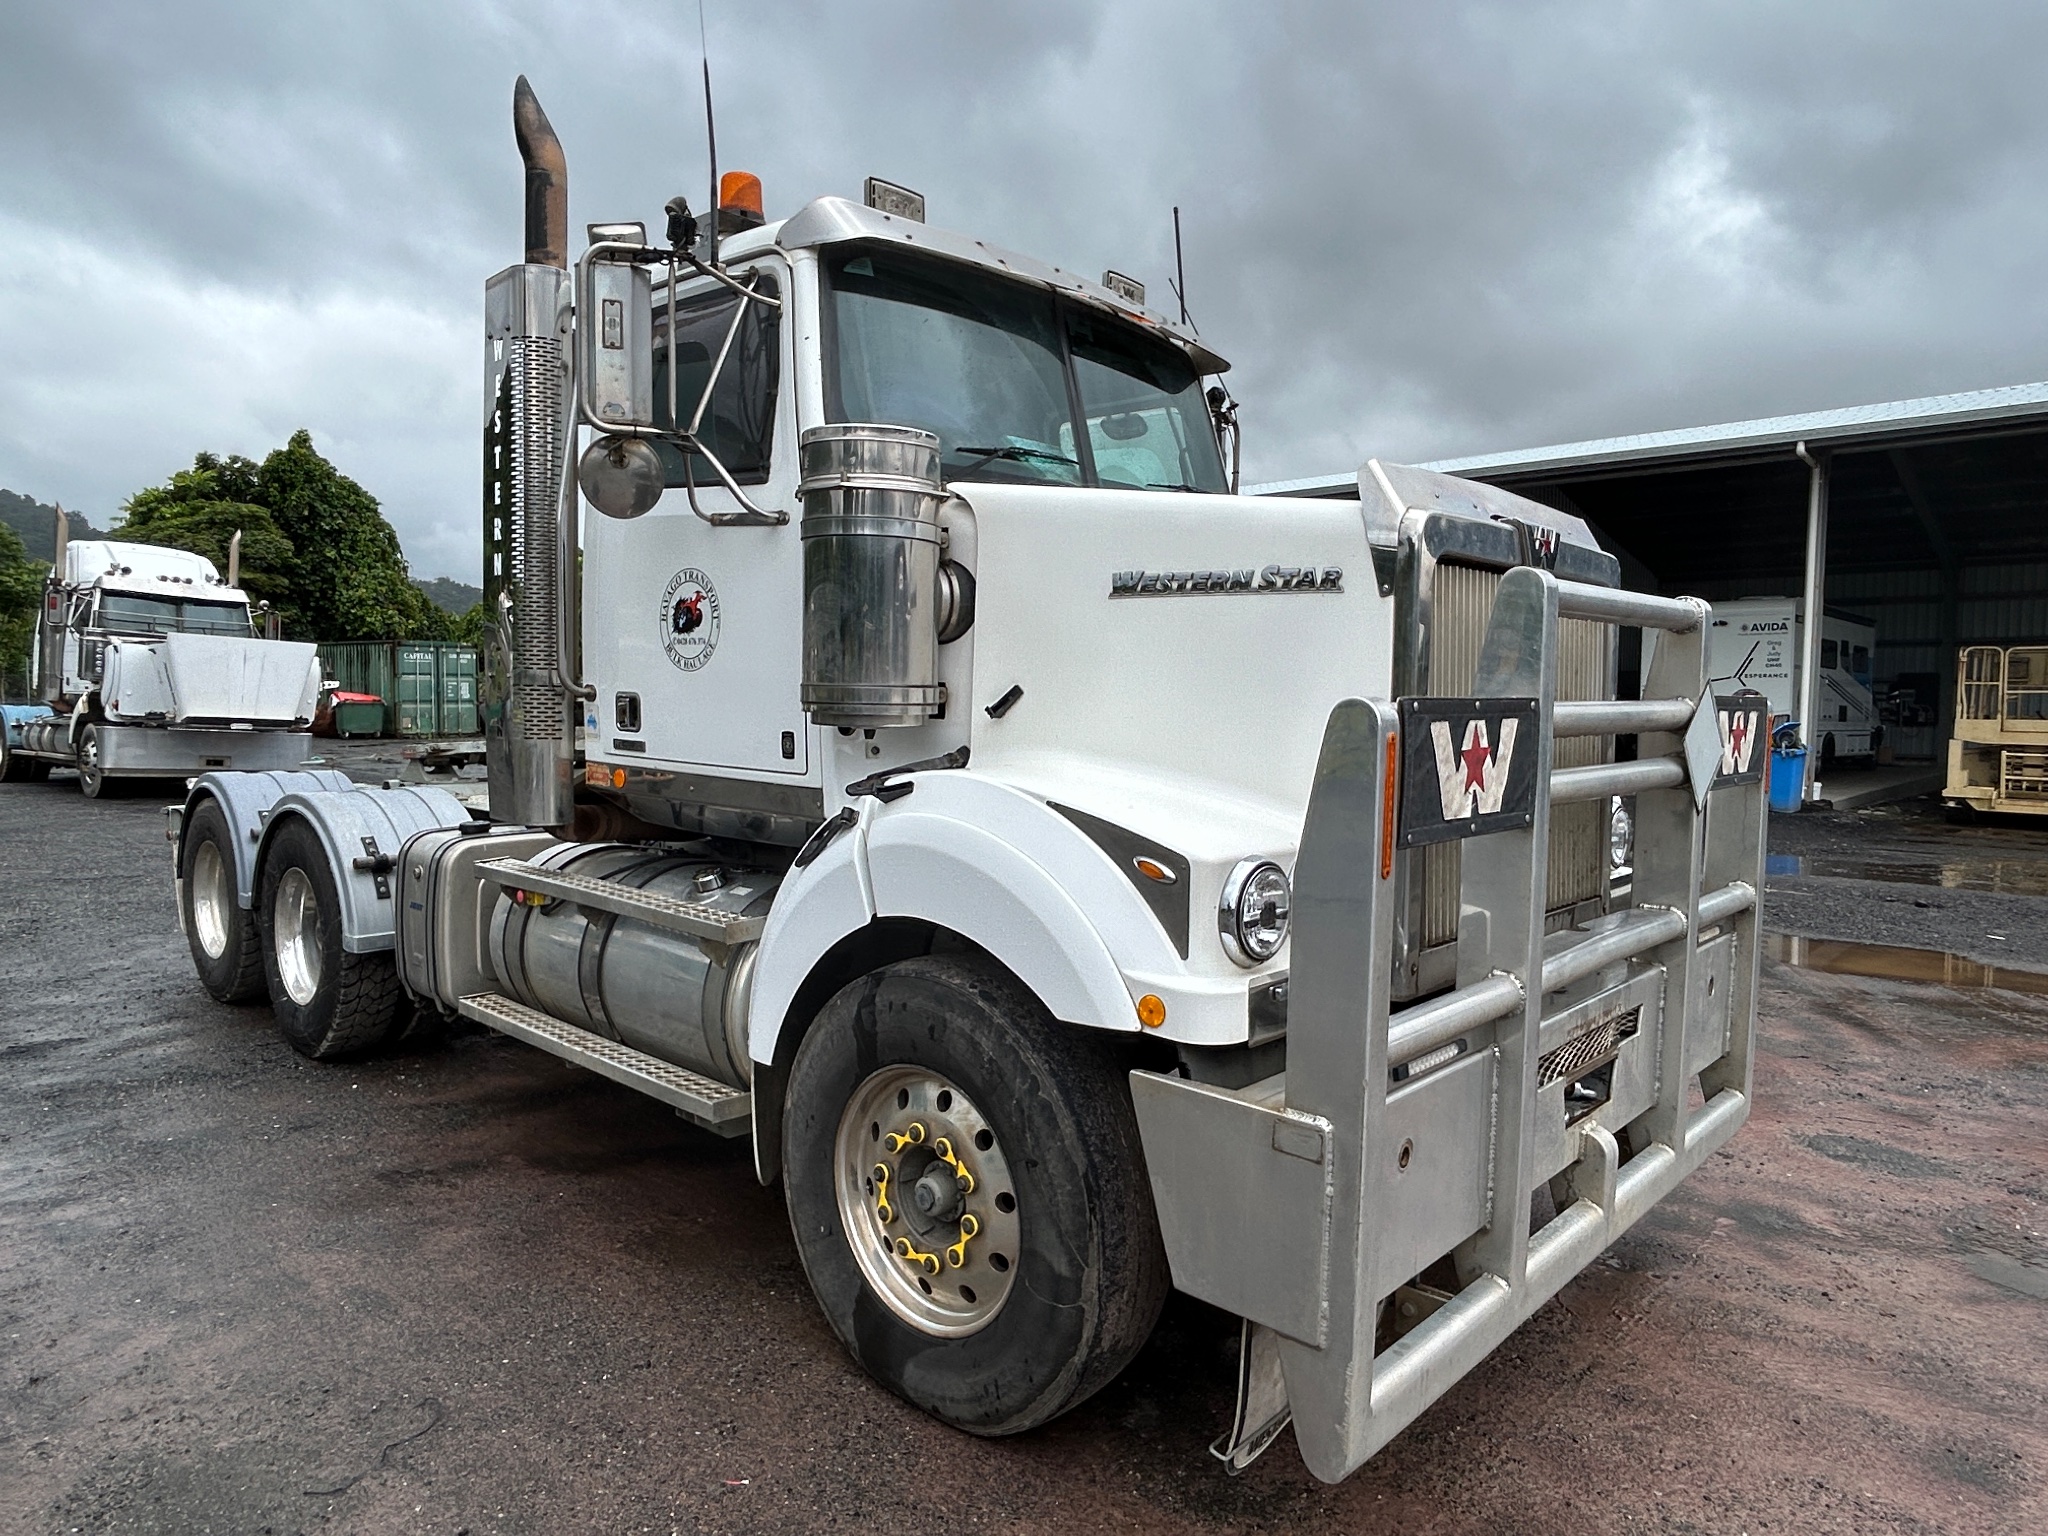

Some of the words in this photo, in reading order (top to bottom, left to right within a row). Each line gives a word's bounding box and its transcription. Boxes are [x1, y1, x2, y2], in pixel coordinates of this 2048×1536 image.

[493, 339, 503, 576] WESTERN
[661, 576, 682, 622] HAVAGO
[683, 570, 719, 621] TRANSPORT
[1111, 570, 1256, 595] WESTERN
[1258, 564, 1343, 592] STAR
[1750, 622, 1788, 632] AVIDA
[403, 652, 433, 660] CAPITAL
[665, 642, 682, 669] BULK
[683, 642, 716, 670] HAULAGE
[1719, 710, 1759, 776] W
[1429, 717, 1520, 822] W
